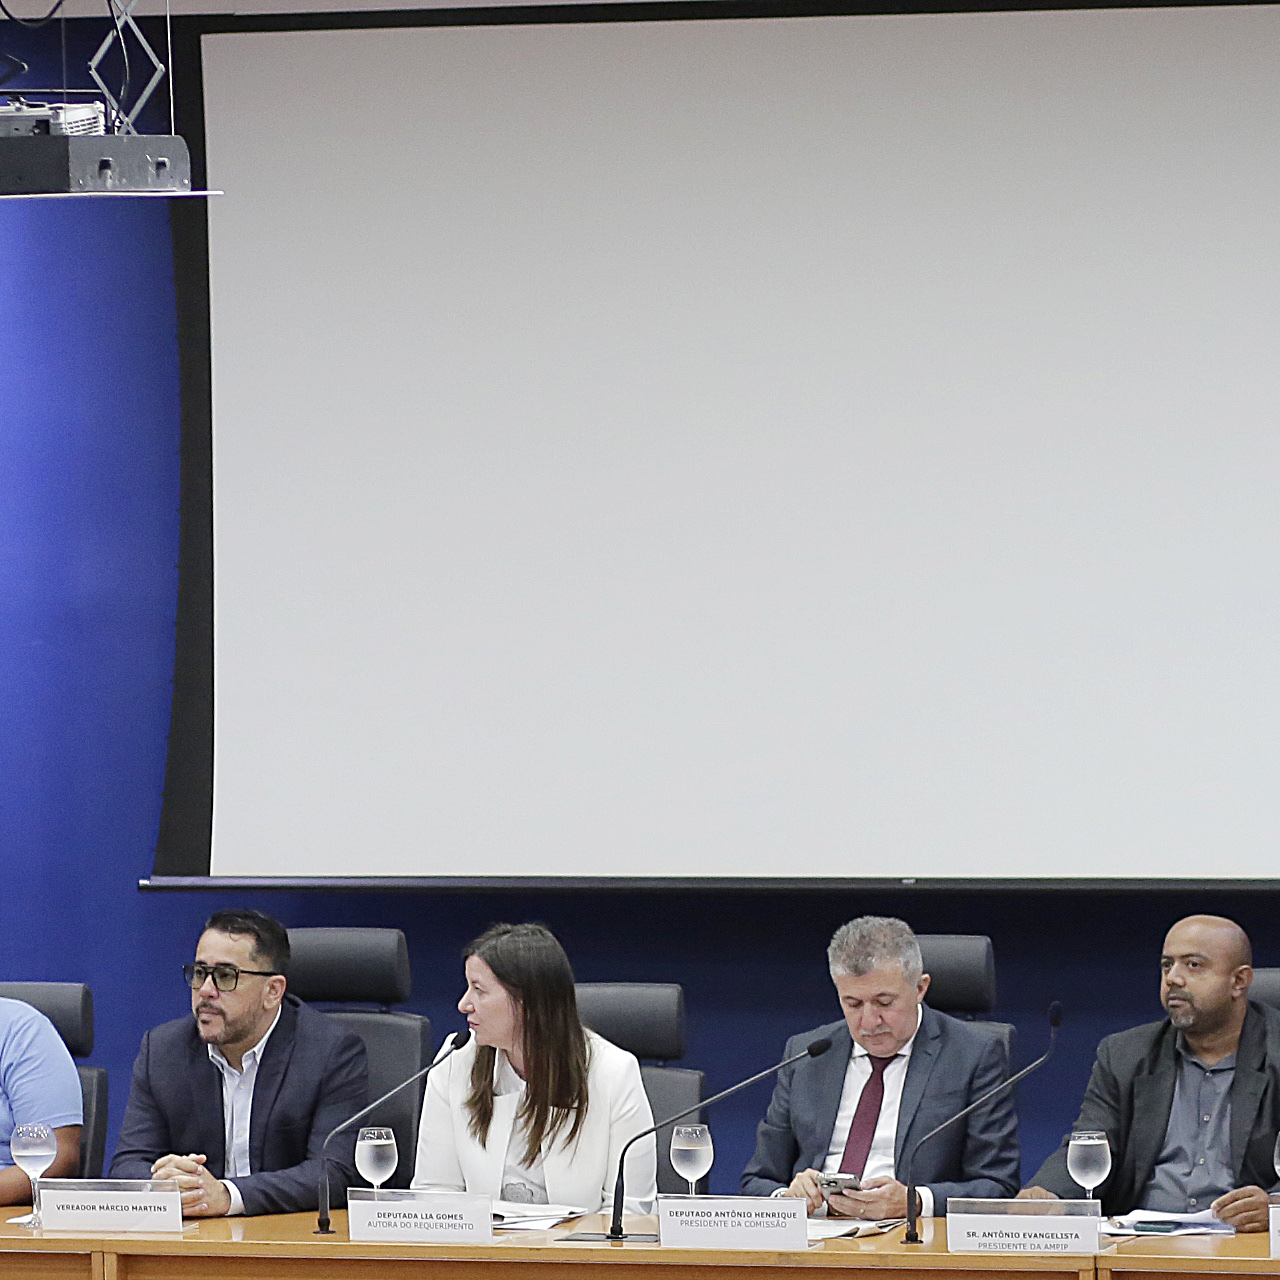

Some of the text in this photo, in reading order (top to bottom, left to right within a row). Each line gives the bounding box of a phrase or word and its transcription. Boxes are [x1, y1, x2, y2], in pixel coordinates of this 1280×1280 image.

[99, 1203, 130, 1212] MÁRCIO
[669, 1209, 797, 1220] DEPUTADO ANTÔNIO HENRIQUE
[400, 1221, 412, 1229] DO
[414, 1222, 474, 1230] REQUERIMENTO
[731, 1220, 742, 1228] DA
[744, 1220, 787, 1229] COMISSÃO
[982, 1230, 1020, 1238] ANTÔNIO
[978, 1242, 1027, 1250] PRESIDENTE
